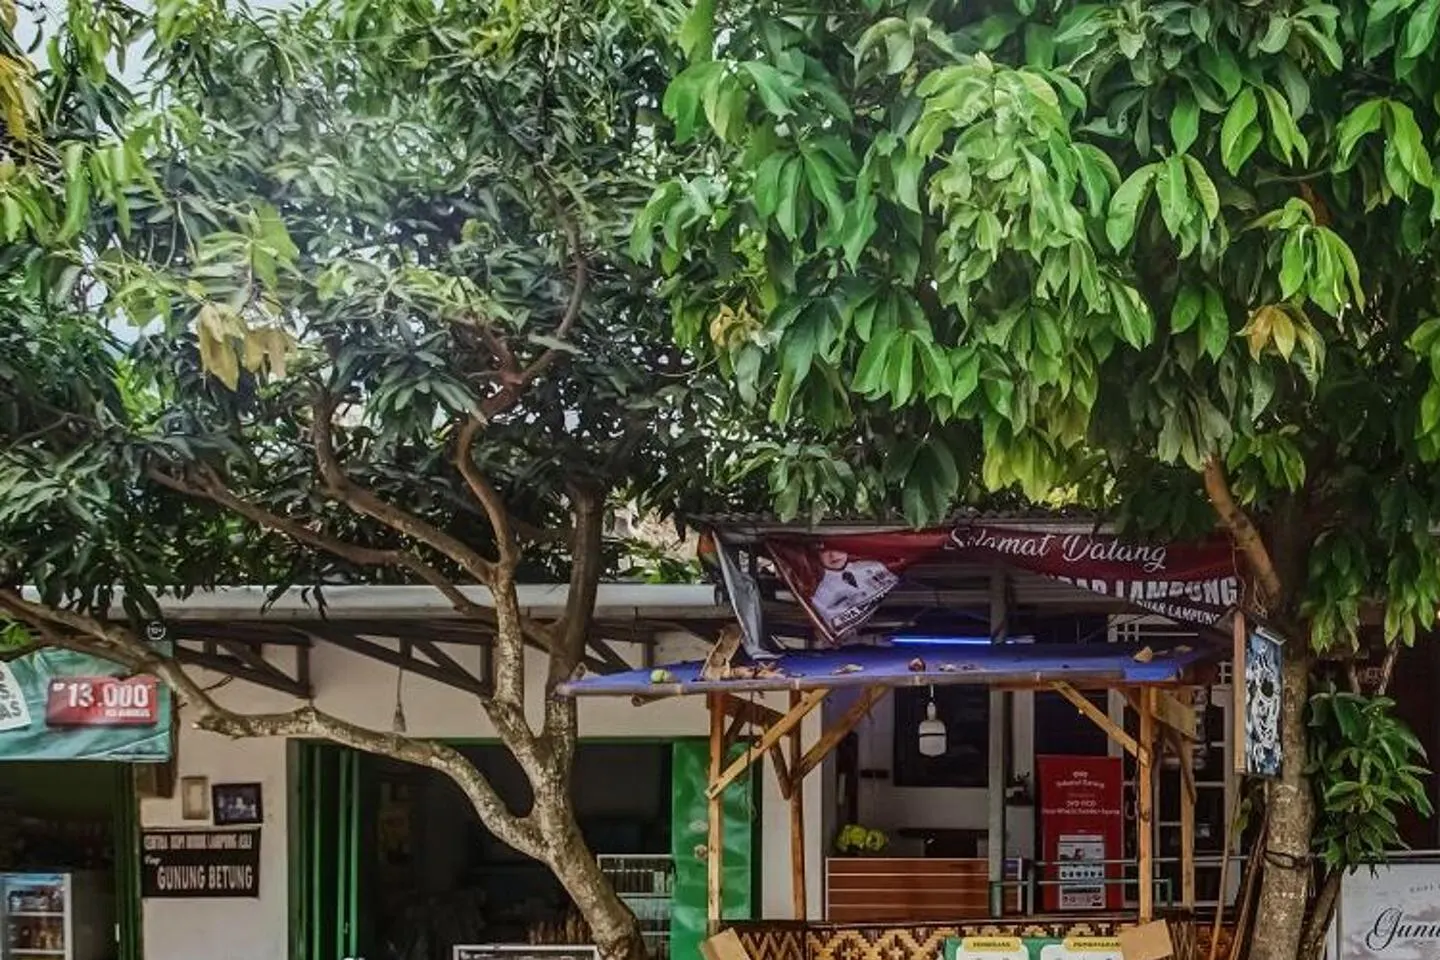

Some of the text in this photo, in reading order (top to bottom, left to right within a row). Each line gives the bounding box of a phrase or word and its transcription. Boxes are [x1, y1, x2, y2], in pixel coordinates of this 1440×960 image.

[945, 528, 1167, 572] Selamat Datang
[157, 865, 253, 890] GUNUNG BETUNG
